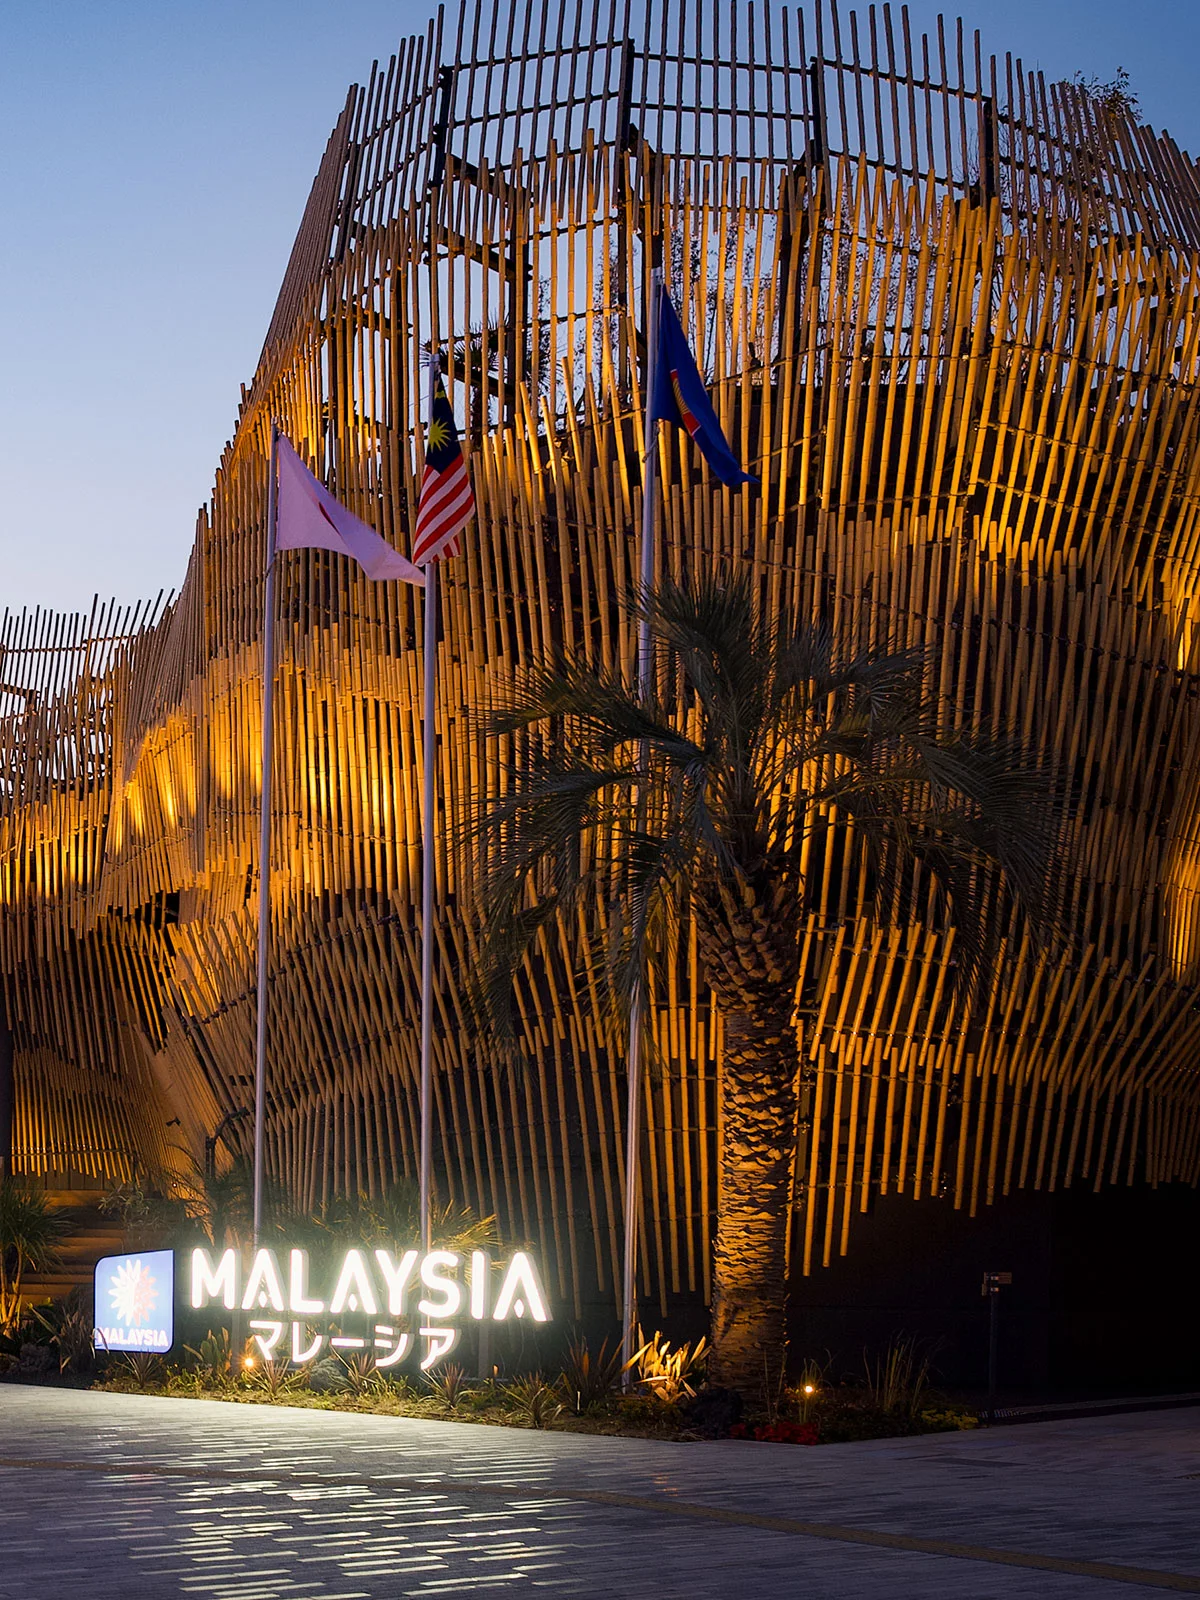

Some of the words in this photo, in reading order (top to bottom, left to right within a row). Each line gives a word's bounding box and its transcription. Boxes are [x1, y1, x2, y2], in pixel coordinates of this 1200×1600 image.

[191, 1247, 549, 1322] MALAYSIA
[97, 1327, 169, 1347] MALAYSIA
[249, 1320, 456, 1370] マレーシア
